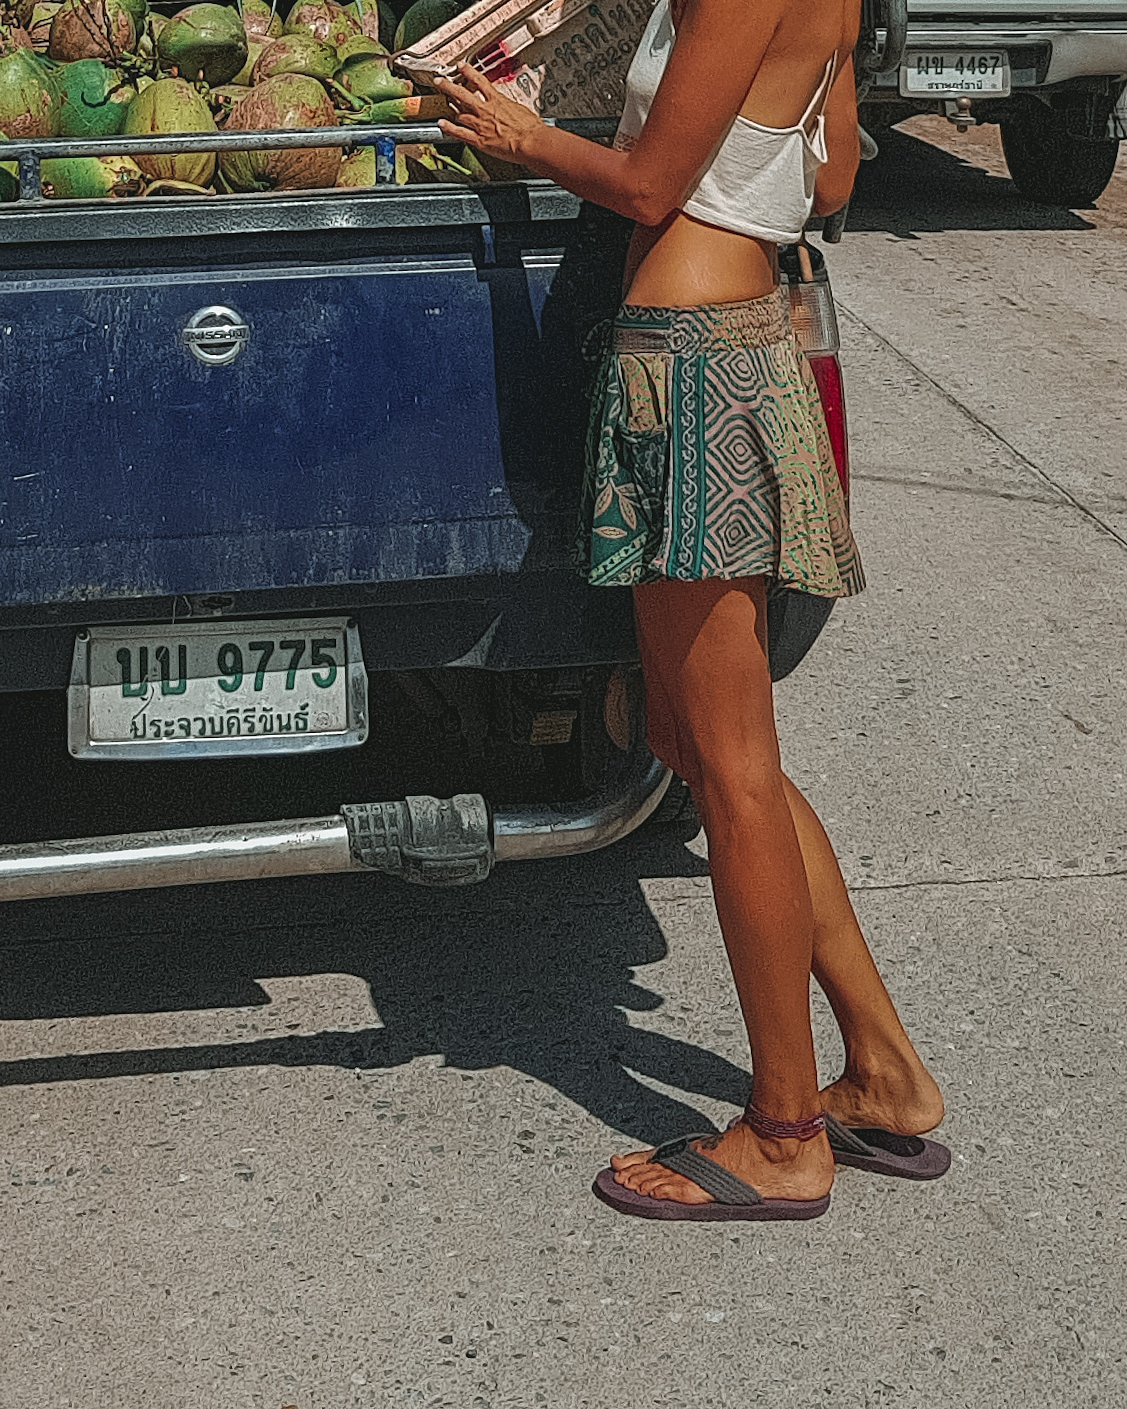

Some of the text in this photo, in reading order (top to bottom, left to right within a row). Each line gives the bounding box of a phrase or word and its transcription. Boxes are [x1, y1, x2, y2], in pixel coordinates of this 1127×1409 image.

[955, 56, 1000, 75] 4467
[217, 638, 338, 693] 9775
[129, 702, 310, 739] ประจวบคีรีขันธ์
